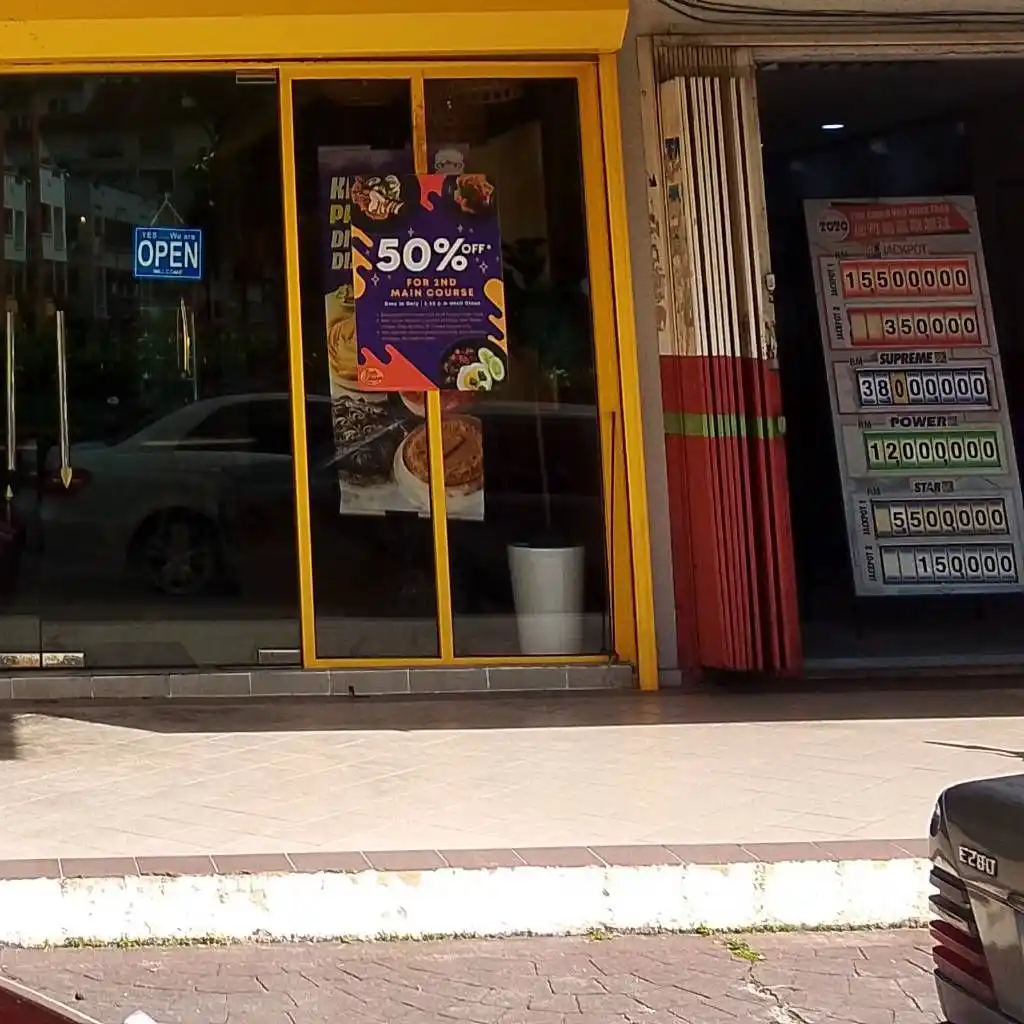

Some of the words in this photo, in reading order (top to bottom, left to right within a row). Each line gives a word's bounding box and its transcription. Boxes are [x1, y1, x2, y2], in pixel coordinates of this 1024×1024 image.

[141, 231, 158, 240] YES
[138, 239, 199, 269] OPEN
[375, 237, 468, 273] 50%
[883, 243, 928, 256] JACKPOT
[406, 277, 430, 287] FOR
[433, 277, 457, 287] 2ND
[390, 287, 422, 298] MAIN
[426, 287, 474, 297] COURSE
[879, 351, 933, 365] SUPREME
[890, 415, 946, 428] POWER
[914, 481, 941, 493] STAR
[958, 844, 998, 877] E280
